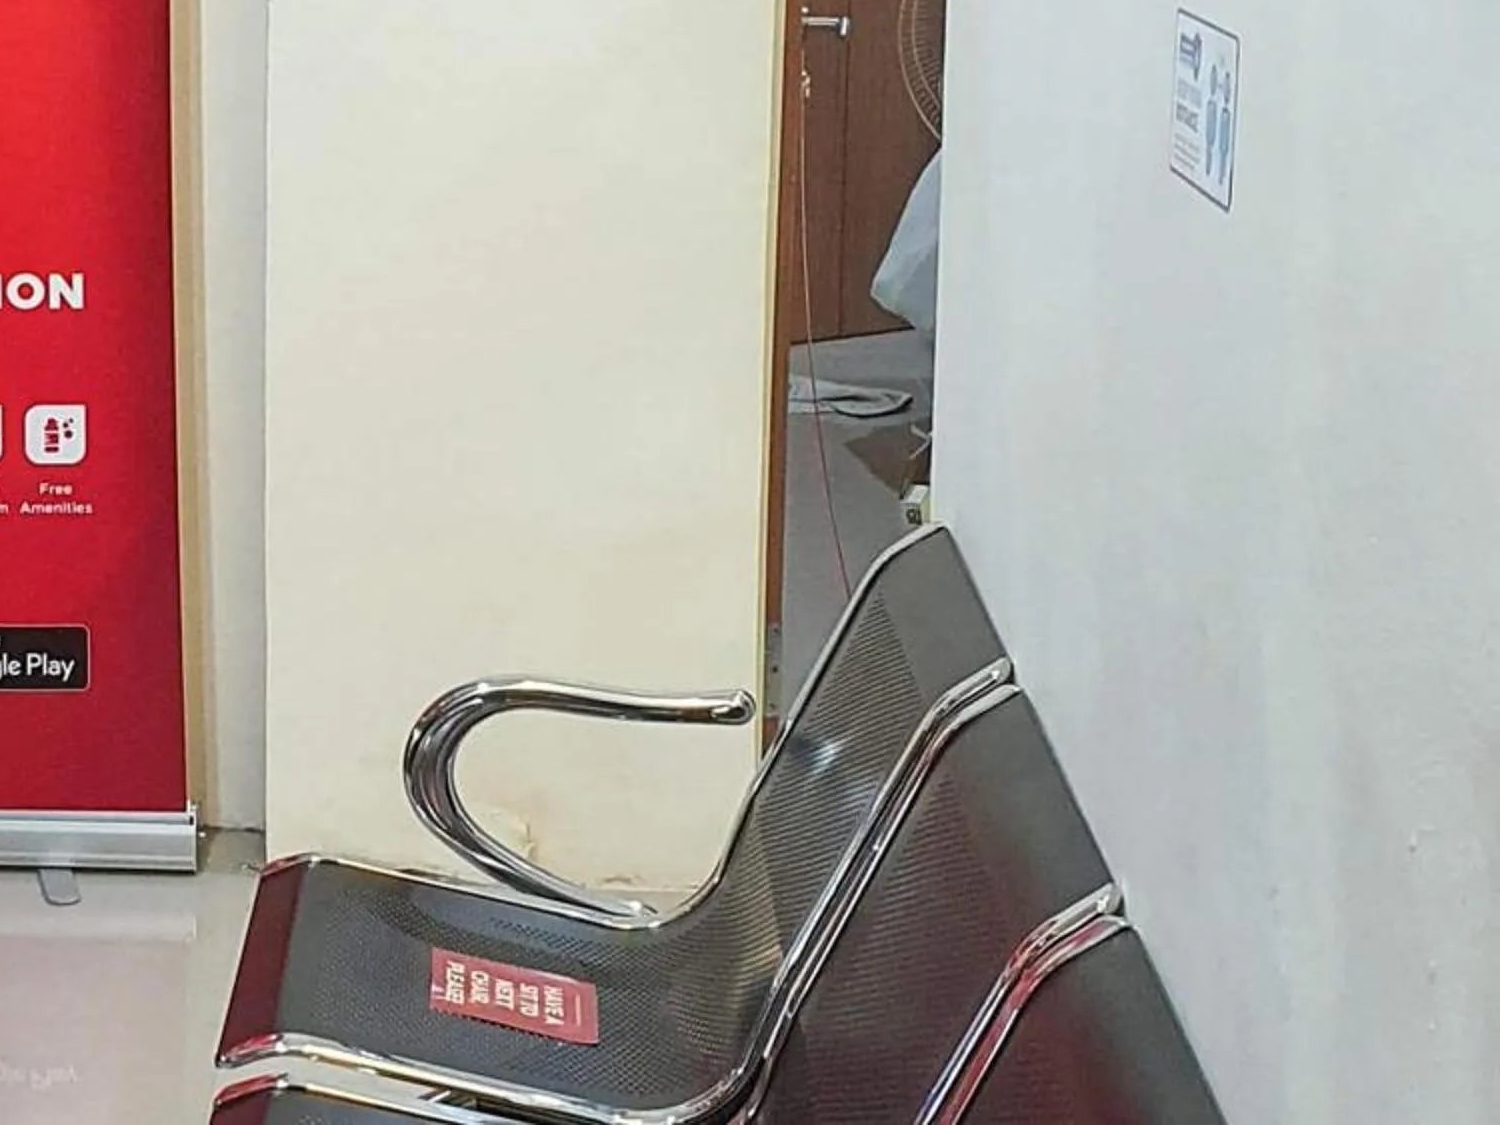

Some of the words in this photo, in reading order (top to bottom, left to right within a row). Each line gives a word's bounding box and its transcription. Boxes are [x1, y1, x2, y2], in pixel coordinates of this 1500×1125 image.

[38, 482, 73, 496] Free
[19, 501, 94, 515] Amenities
[26, 653, 76, 682] Play
[470, 970, 490, 1005] CHAIR
